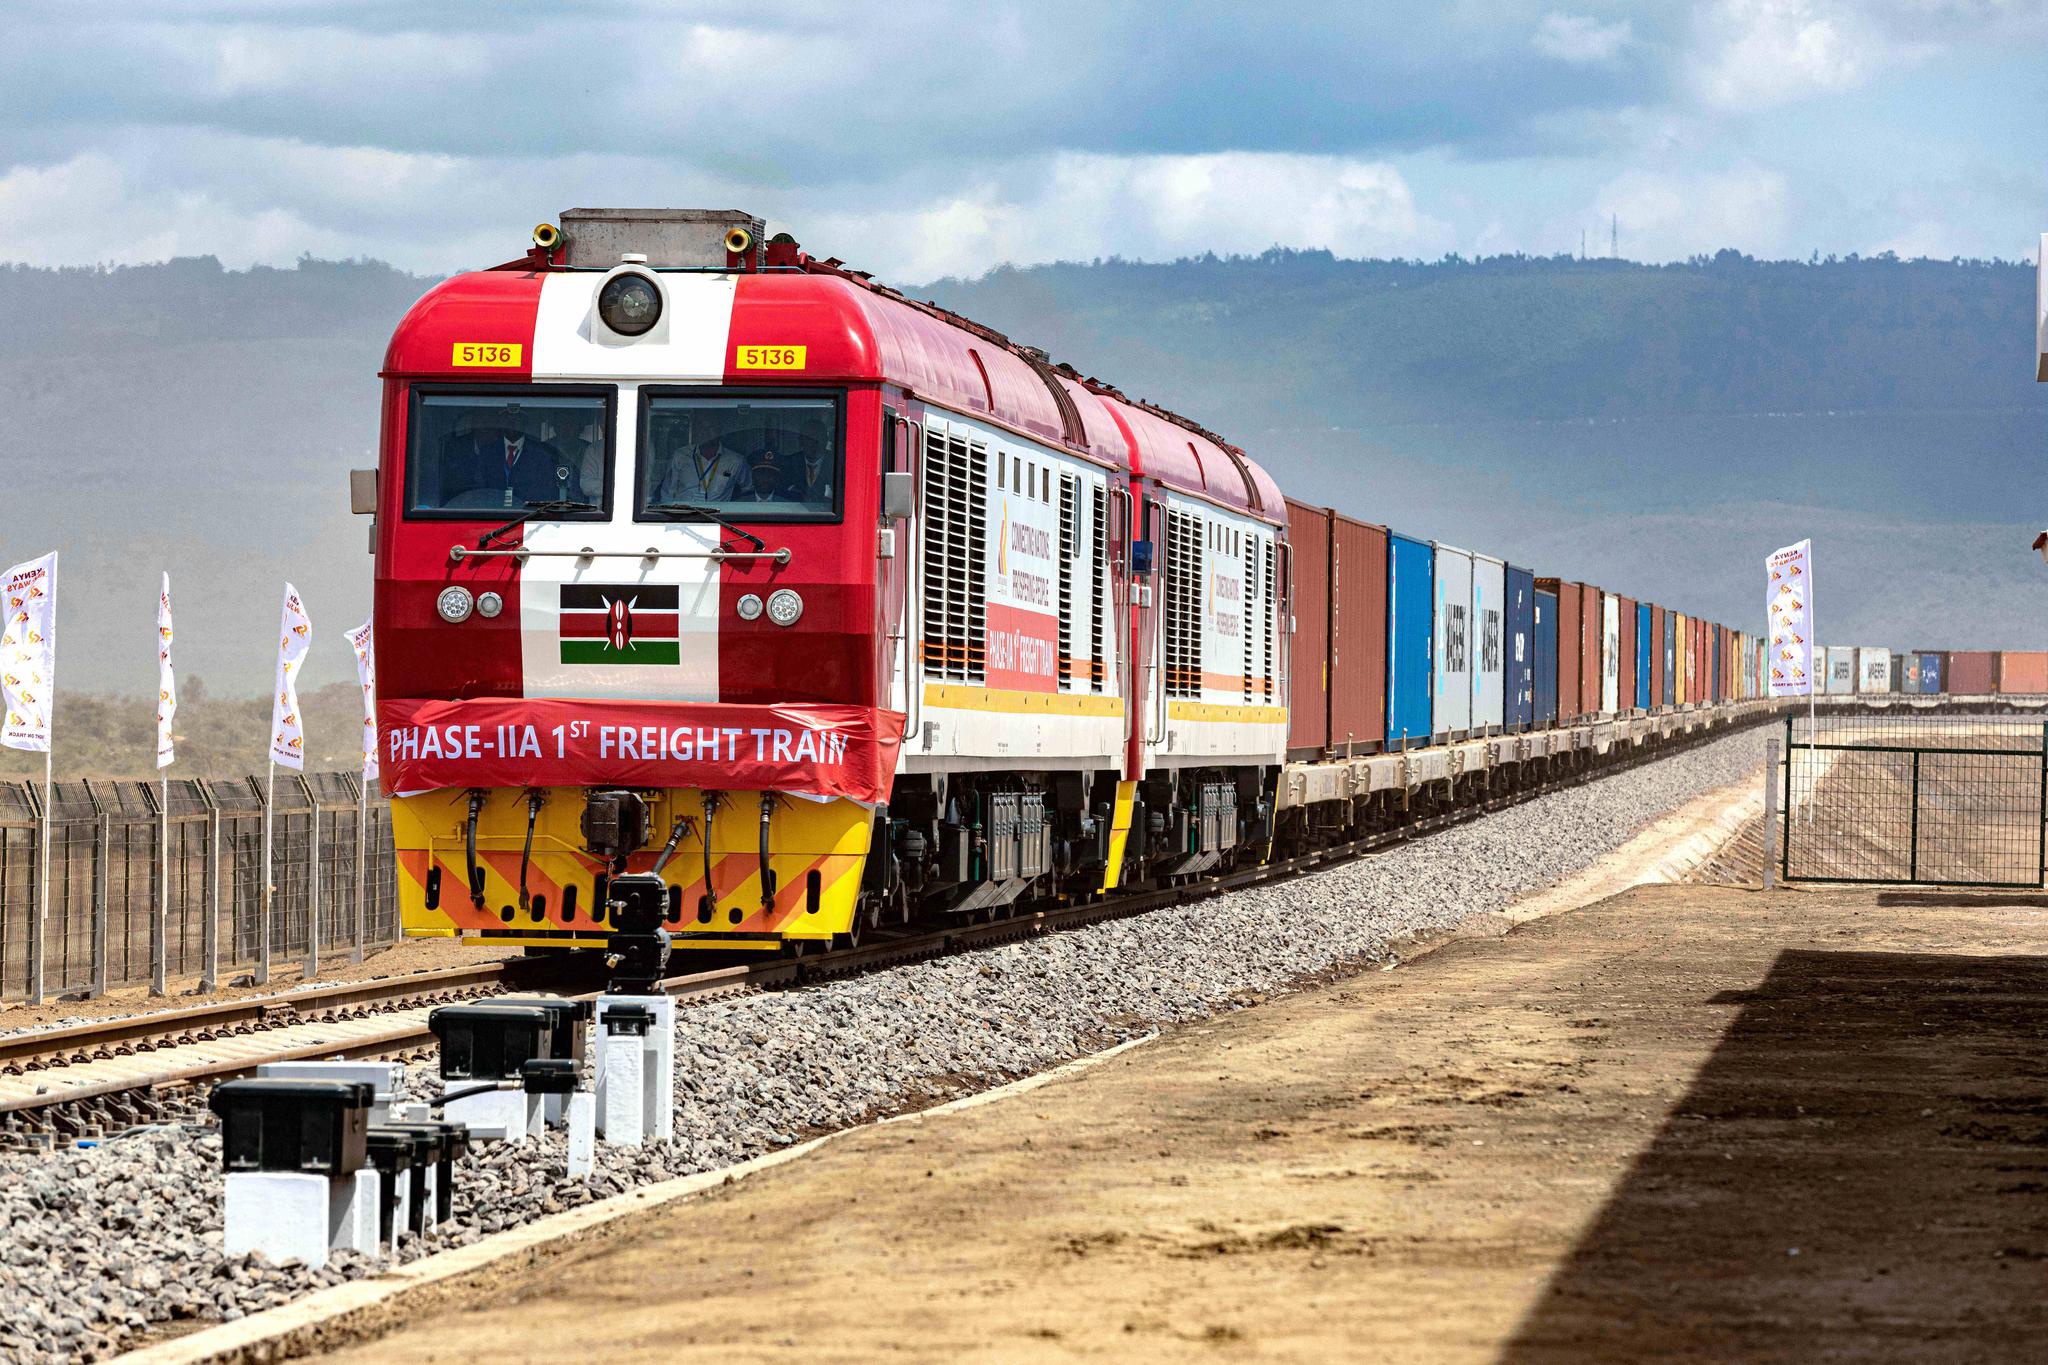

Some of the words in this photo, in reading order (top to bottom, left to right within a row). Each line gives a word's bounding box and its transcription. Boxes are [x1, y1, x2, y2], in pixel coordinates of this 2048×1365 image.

[463, 346, 511, 362] 5136
[747, 349, 795, 365] 5136
[390, 725, 542, 763] PHASE-IIA
[551, 721, 590, 759] 1ST
[600, 726, 742, 761] FREIGHT
[751, 728, 849, 765] TRAIN
